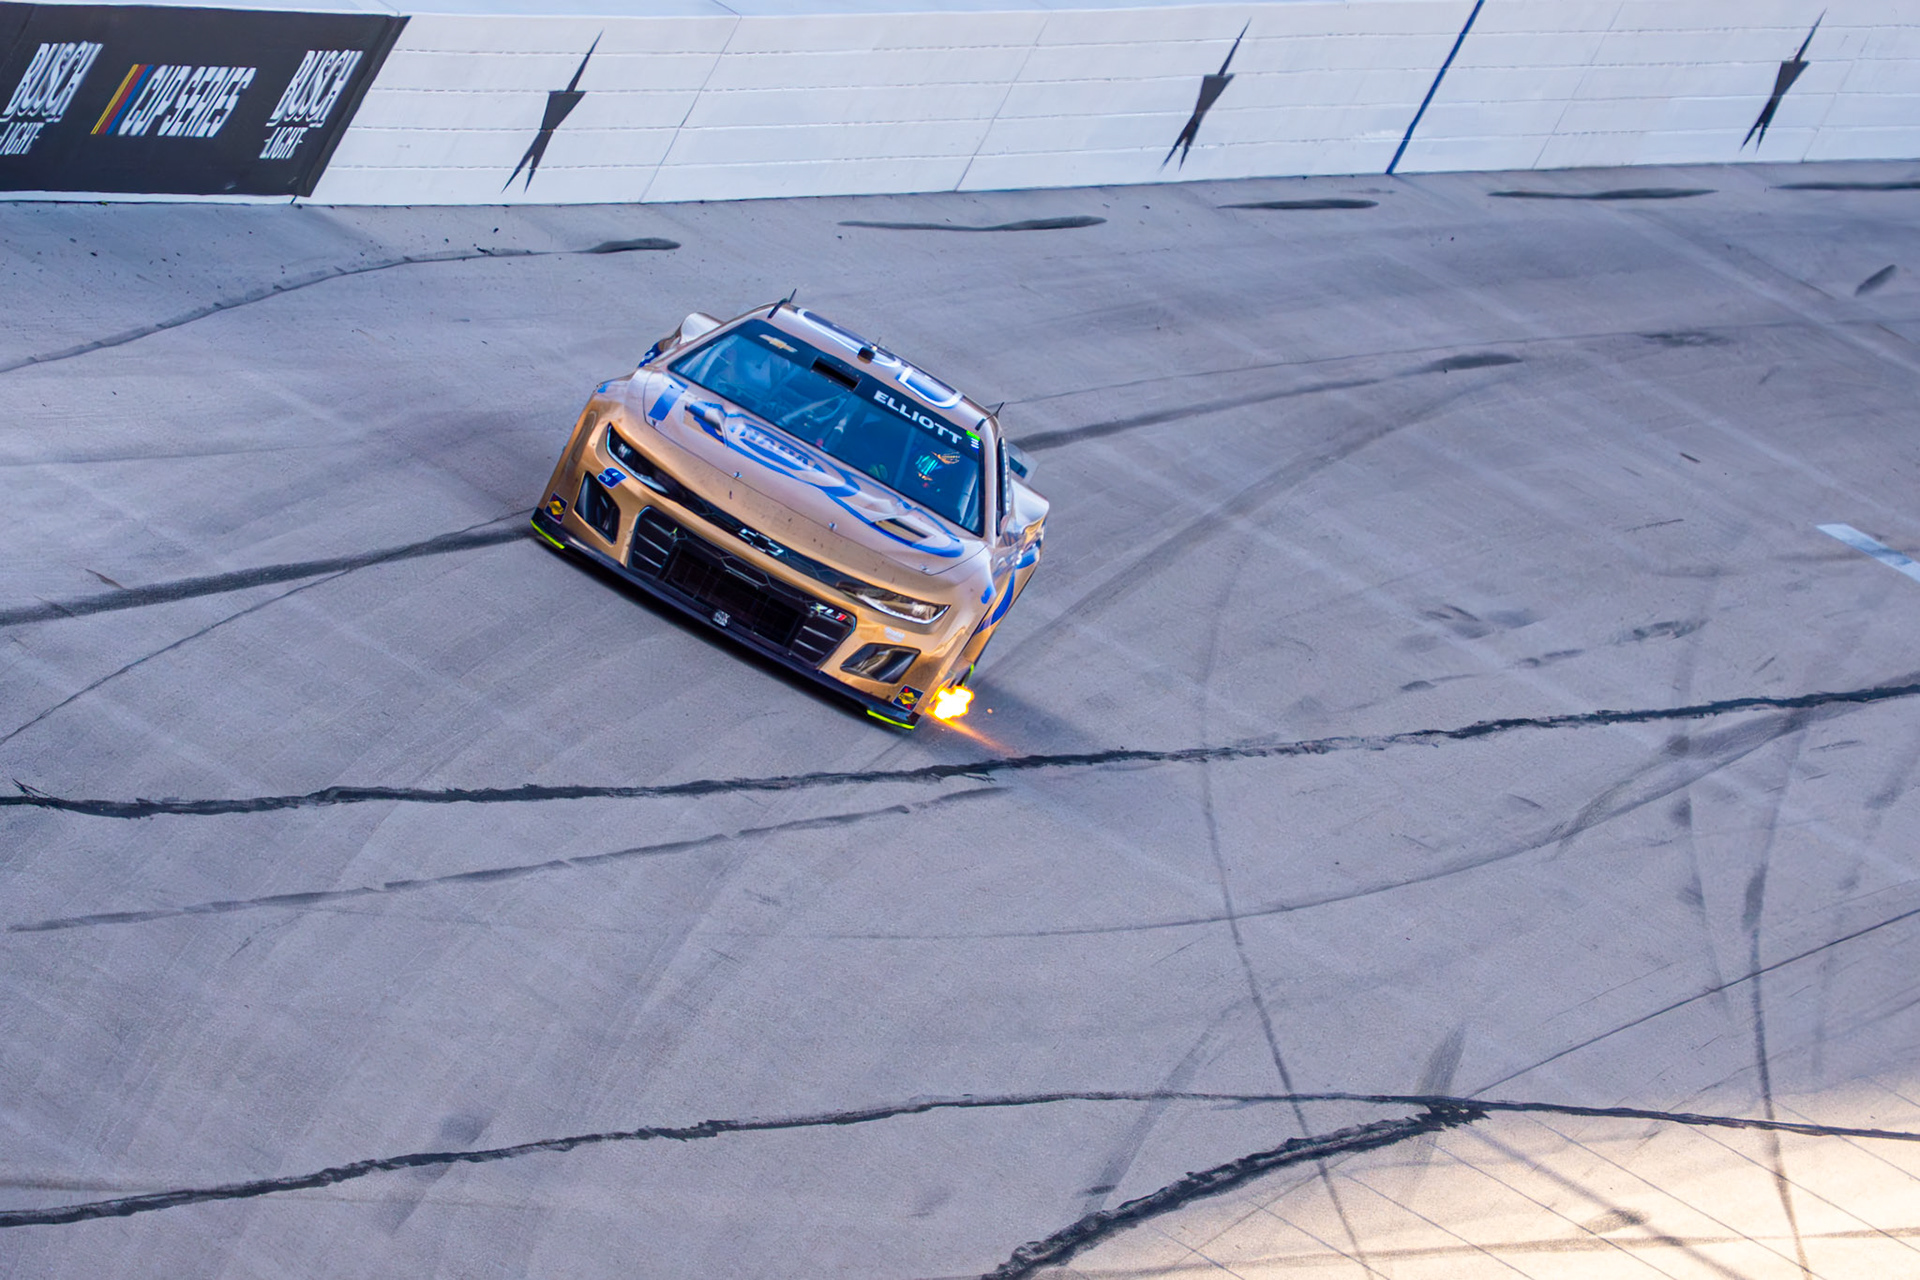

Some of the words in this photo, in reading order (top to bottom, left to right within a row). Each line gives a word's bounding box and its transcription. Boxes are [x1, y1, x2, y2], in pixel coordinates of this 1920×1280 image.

[1, 41, 104, 122] BUSCH
[118, 64, 192, 136] CUP
[157, 65, 257, 137] SERIES
[267, 49, 363, 127] BUSCH
[259, 127, 308, 159] LIGHT
[873, 390, 962, 444] ELLIOTT
[597, 467, 627, 489] 9
